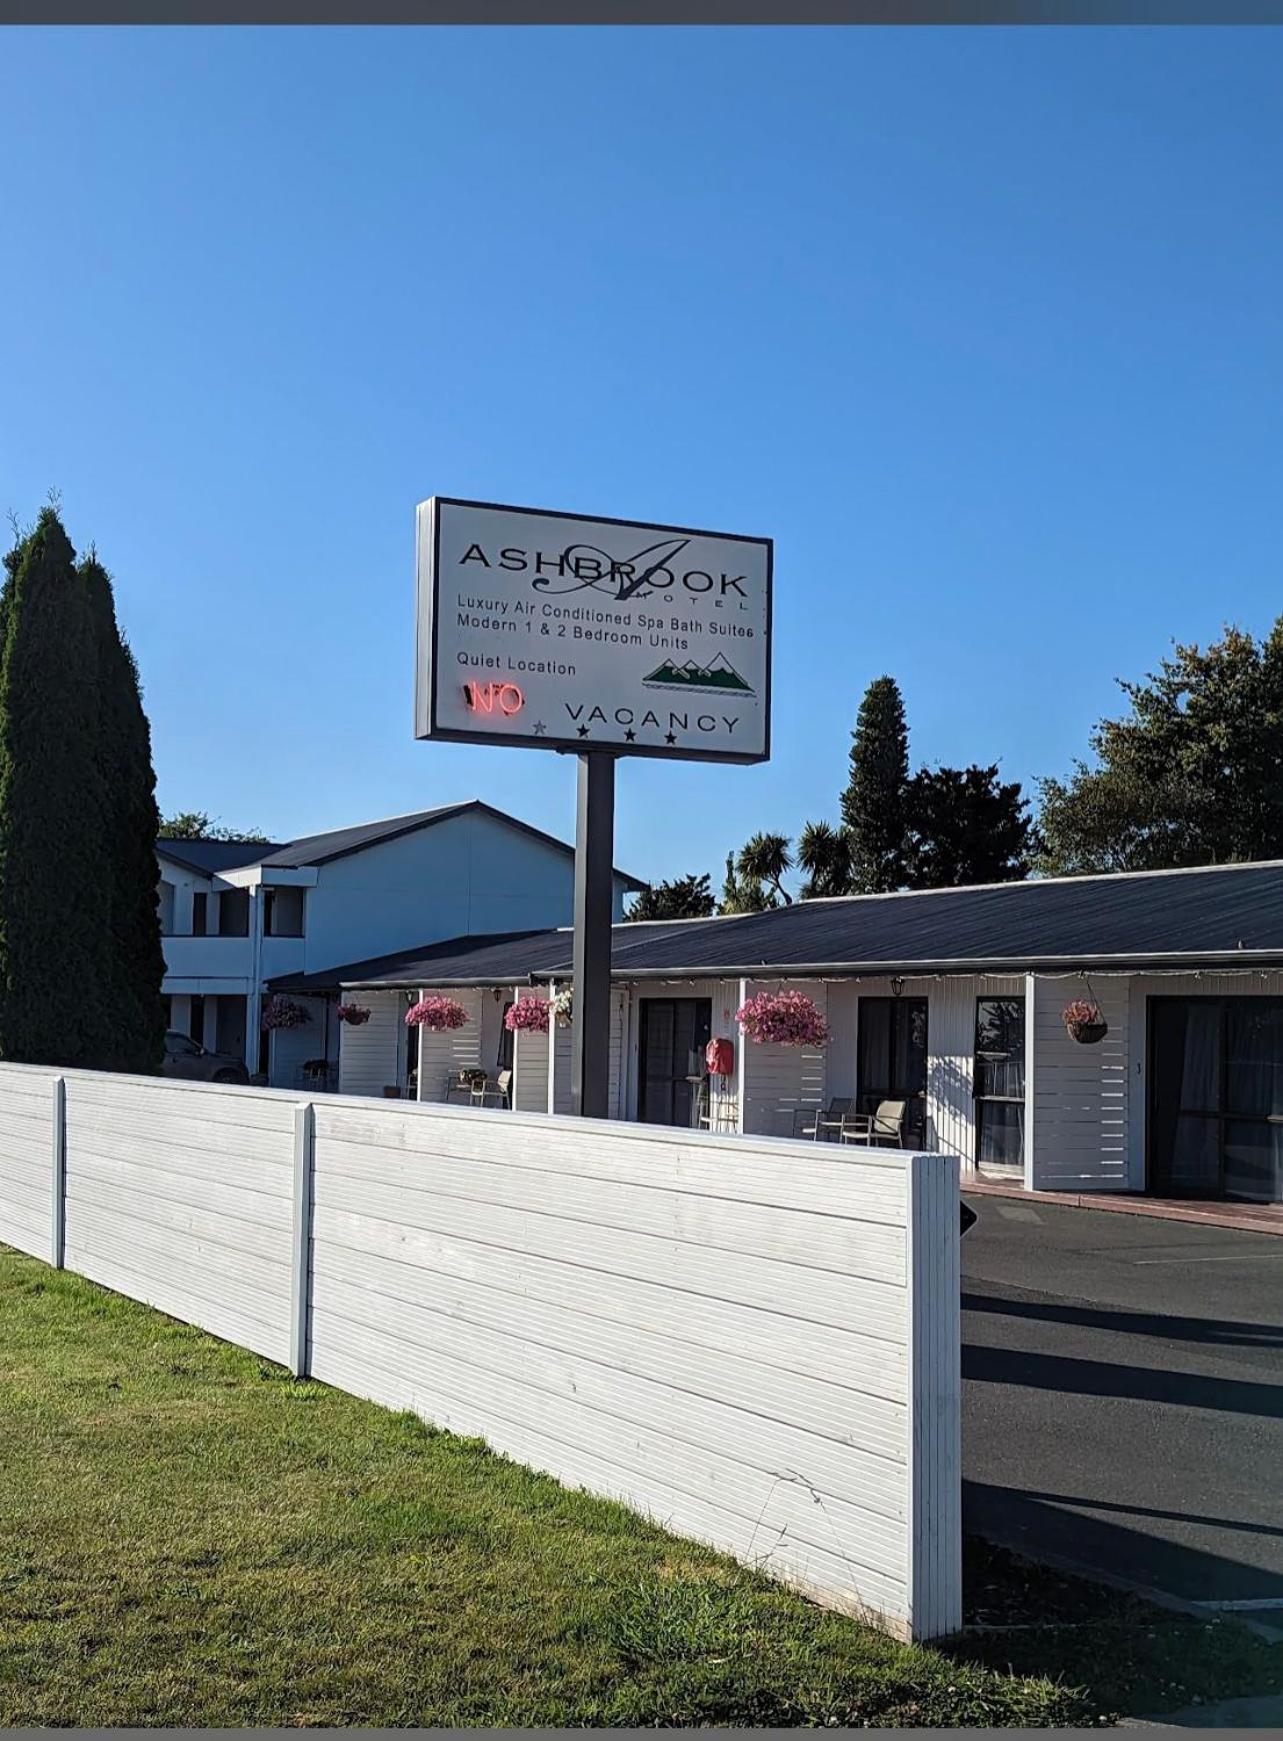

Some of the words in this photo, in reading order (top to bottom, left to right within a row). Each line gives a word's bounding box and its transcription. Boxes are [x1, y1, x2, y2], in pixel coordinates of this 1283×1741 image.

[459, 543, 748, 597] ASHBROOK
[456, 613, 517, 632] Modern
[524, 621, 532, 633] 1
[540, 622, 551, 636] &
[557, 624, 567, 638] 2
[573, 626, 642, 646] Bedroom
[649, 633, 689, 650] Units
[457, 593, 509, 615] Luxury
[514, 601, 536, 615] Air
[541, 603, 632, 627] Conditioned
[637, 614, 664, 631] Spa
[670, 618, 703, 634] Bath
[708, 622, 754, 638] Suites
[456, 651, 501, 669] Quiet
[507, 656, 577, 676] Location
[470, 680, 523, 714] NO
[565, 702, 740, 734] VACANCY
